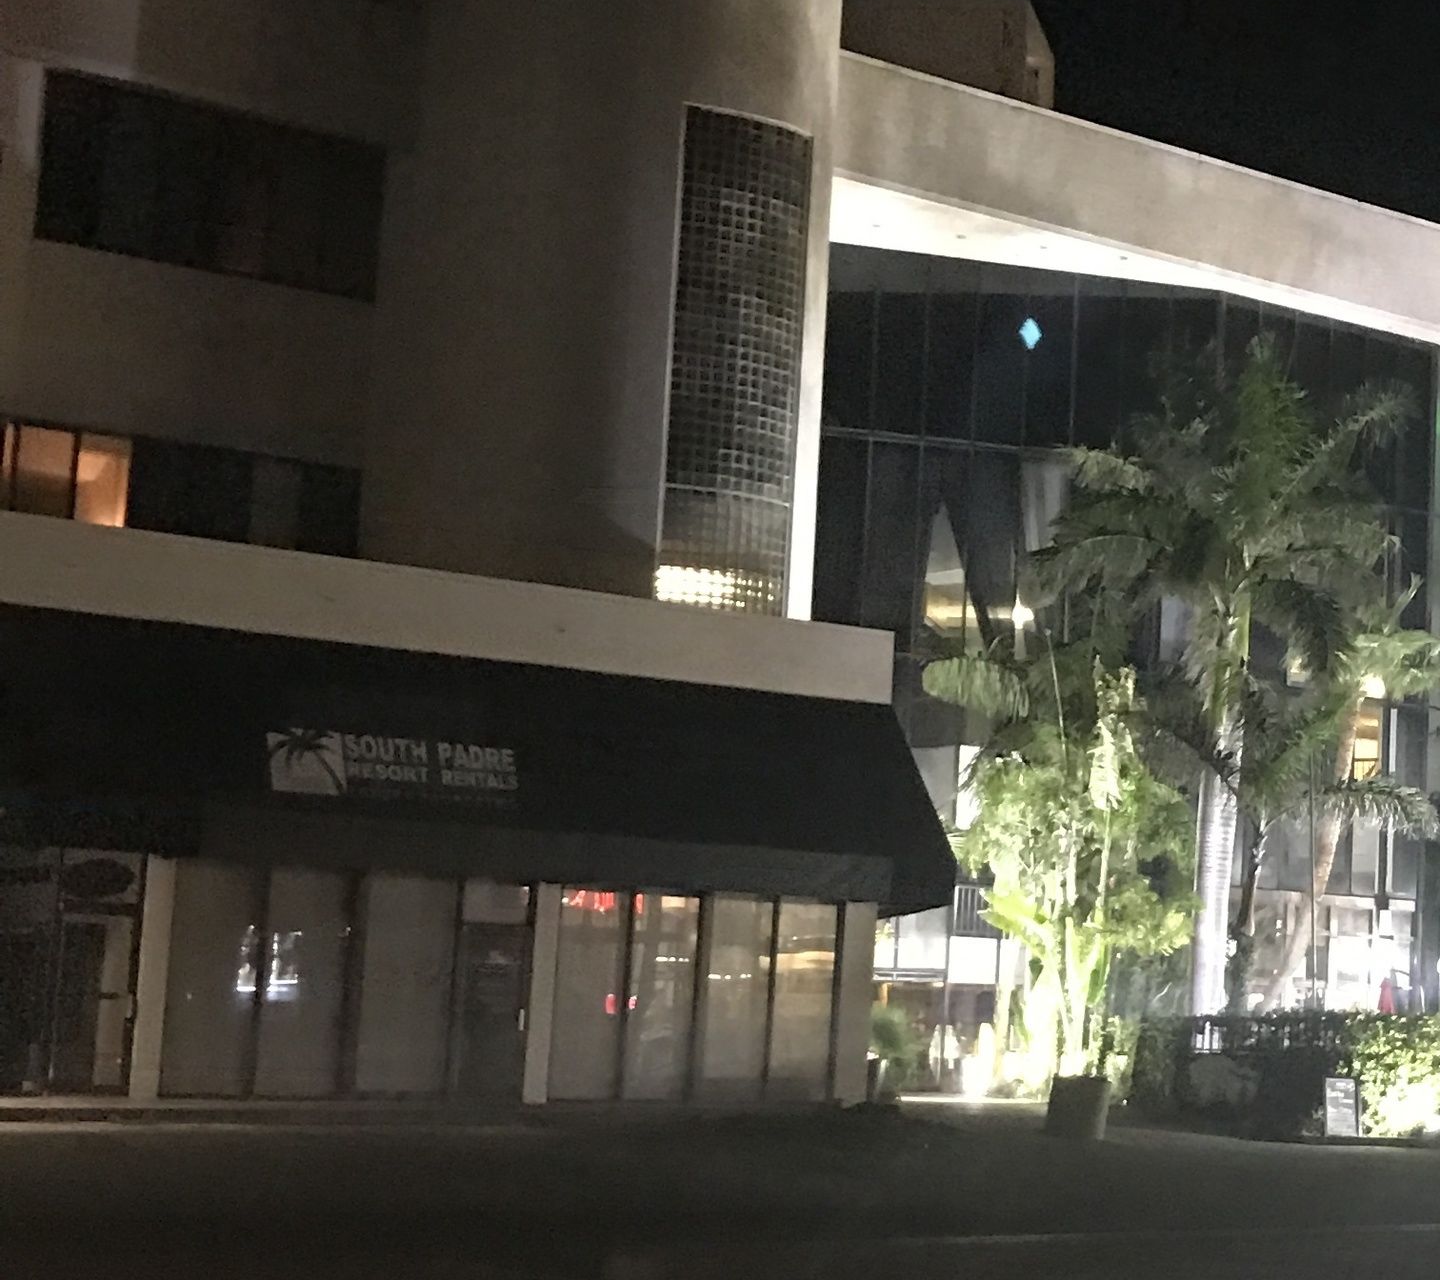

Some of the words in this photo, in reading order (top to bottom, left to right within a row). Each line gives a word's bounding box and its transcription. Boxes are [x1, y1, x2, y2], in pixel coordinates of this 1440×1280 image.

[346, 733, 428, 763] SOUTH
[437, 742, 515, 771] PADRE
[350, 760, 429, 783] RESORT
[441, 771, 519, 791] RENTALS
